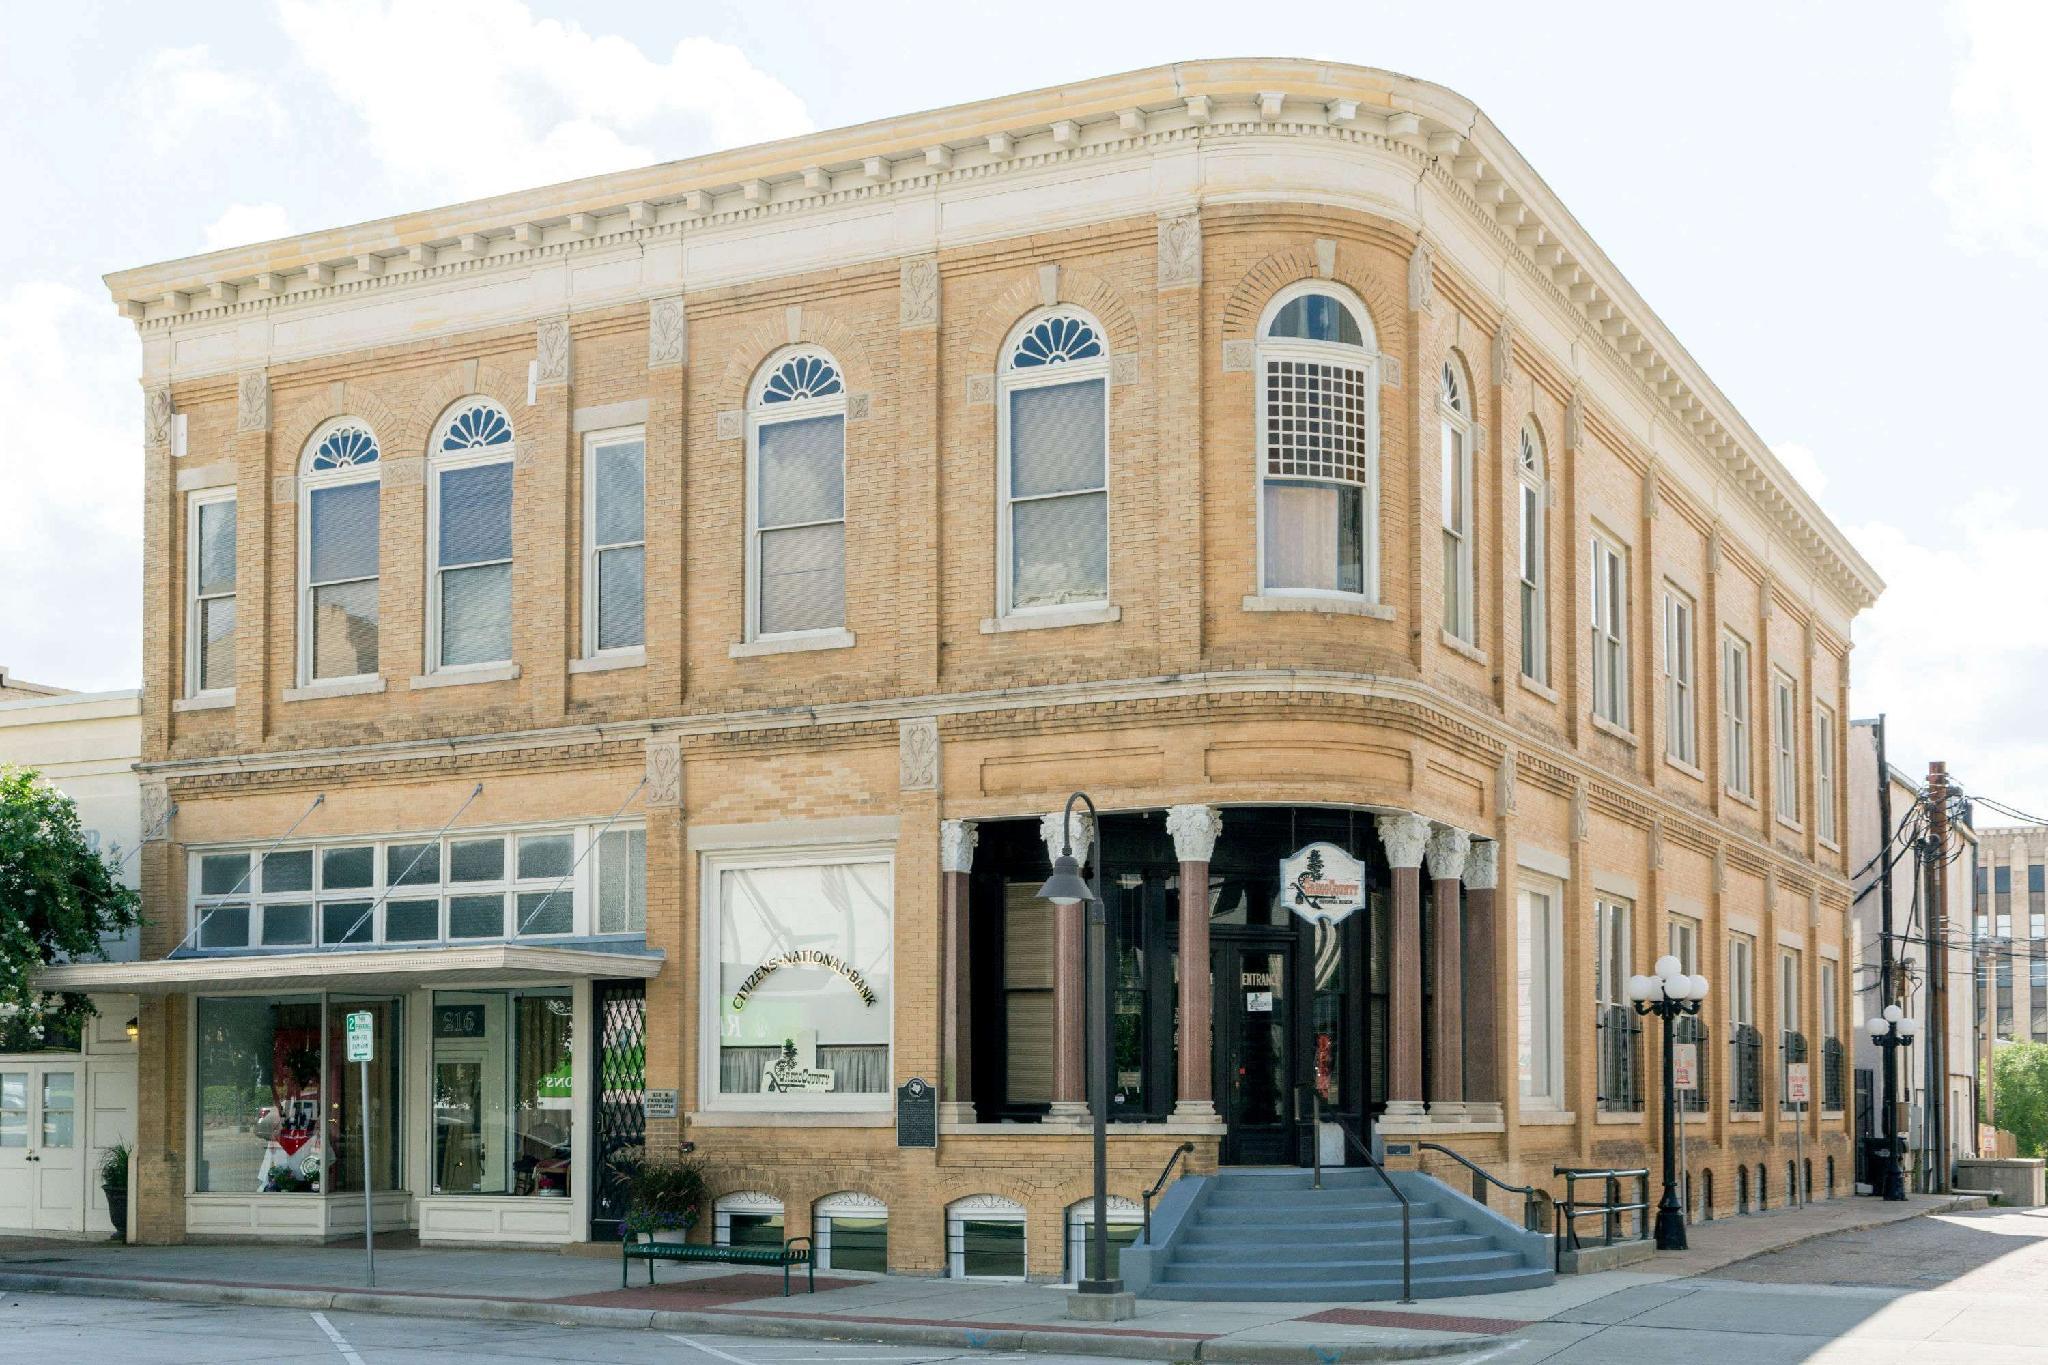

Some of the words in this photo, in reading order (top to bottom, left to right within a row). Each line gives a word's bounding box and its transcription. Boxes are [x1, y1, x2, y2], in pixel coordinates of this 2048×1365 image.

[733, 957, 778, 1010] CITIZENS
[783, 950, 847, 976] NATIONAL
[848, 970, 877, 1008] BANK
[349, 1017, 355, 1030] 2
